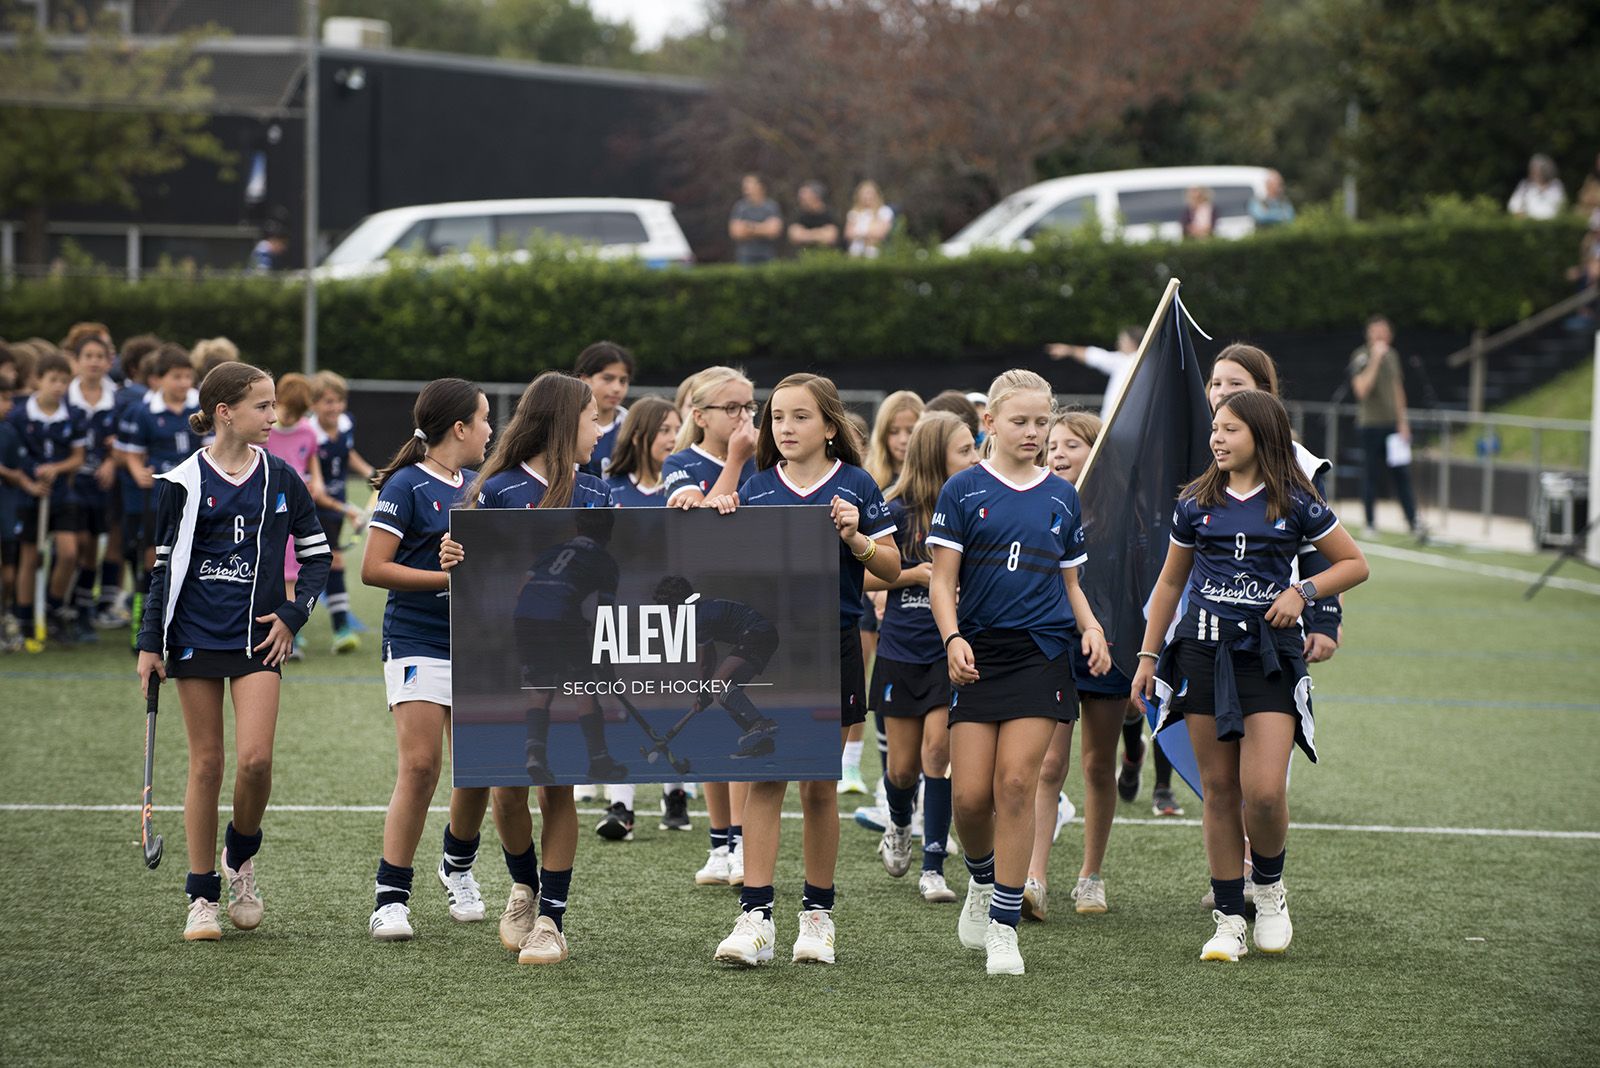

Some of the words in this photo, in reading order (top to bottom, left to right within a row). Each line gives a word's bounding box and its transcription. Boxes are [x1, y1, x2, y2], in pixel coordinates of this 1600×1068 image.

[234, 514, 245, 544] 6
[1006, 540, 1021, 572] 8
[1234, 532, 1247, 561] 9
[199, 559, 238, 580] Enjoy
[549, 549, 577, 575] 8
[1200, 578, 1246, 604] Enjoy
[591, 592, 701, 665] ALEVÍ
[563, 678, 626, 696] SECCIÓ
[631, 680, 655, 694] DE
[660, 679, 732, 694] HOCKEY
